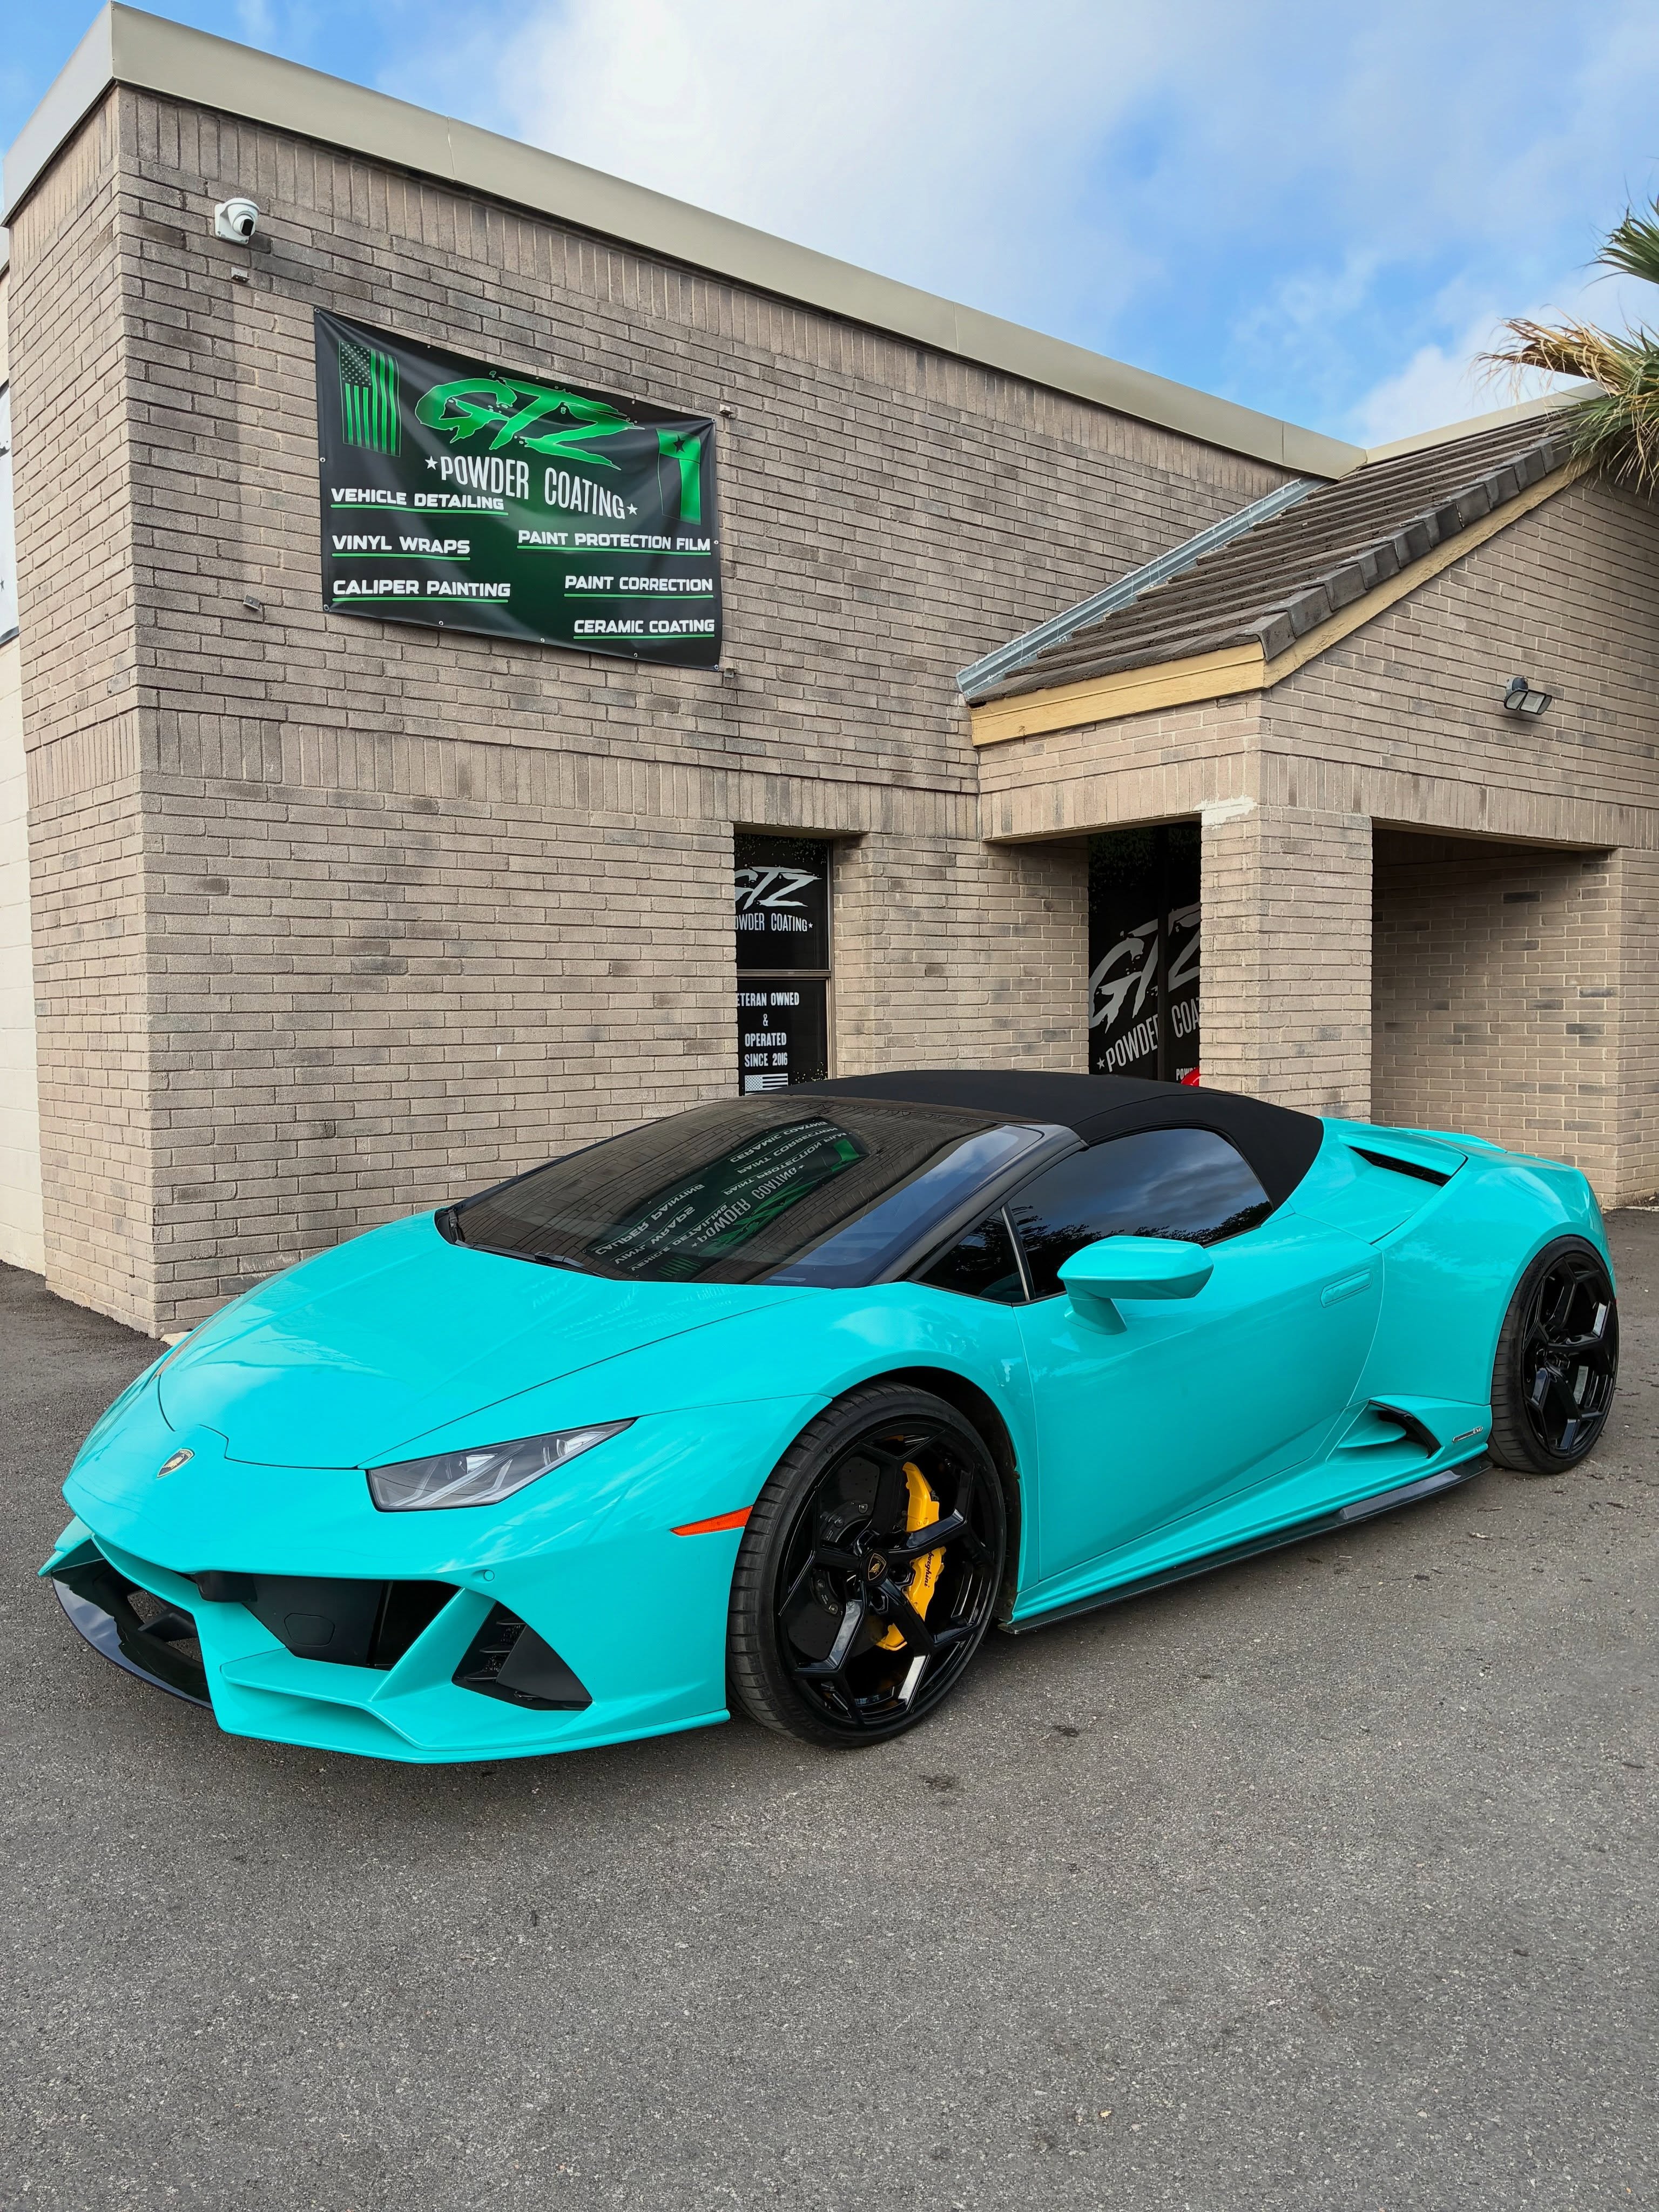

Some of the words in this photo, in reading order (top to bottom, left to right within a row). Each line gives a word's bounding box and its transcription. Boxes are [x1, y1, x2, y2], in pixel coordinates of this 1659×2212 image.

[415, 376, 645, 470] GTZ
[441, 456, 529, 500] POWDER
[544, 467, 625, 520] COATING
[331, 488, 407, 507] VEHICLE
[414, 493, 504, 510] DETAILING
[332, 535, 393, 551] VINYL
[399, 536, 470, 554] WRAPS
[518, 529, 569, 546] PAINT
[574, 532, 671, 550] PROTECTION
[676, 537, 711, 551] FILM
[333, 579, 419, 595] CALIPER
[427, 581, 511, 597] PAINTING
[565, 575, 614, 590] PAINT
[619, 577, 713, 591] CORRECTION
[574, 619, 644, 633] CERAMIC
[649, 619, 715, 633] COATING
[771, 913, 807, 932] COATING
[771, 992, 799, 1006] OWNED
[763, 1014, 768, 1027] &
[745, 1032, 787, 1047] OPERATED
[744, 1053, 768, 1067] SINCE
[772, 1052, 788, 1066] 2016
